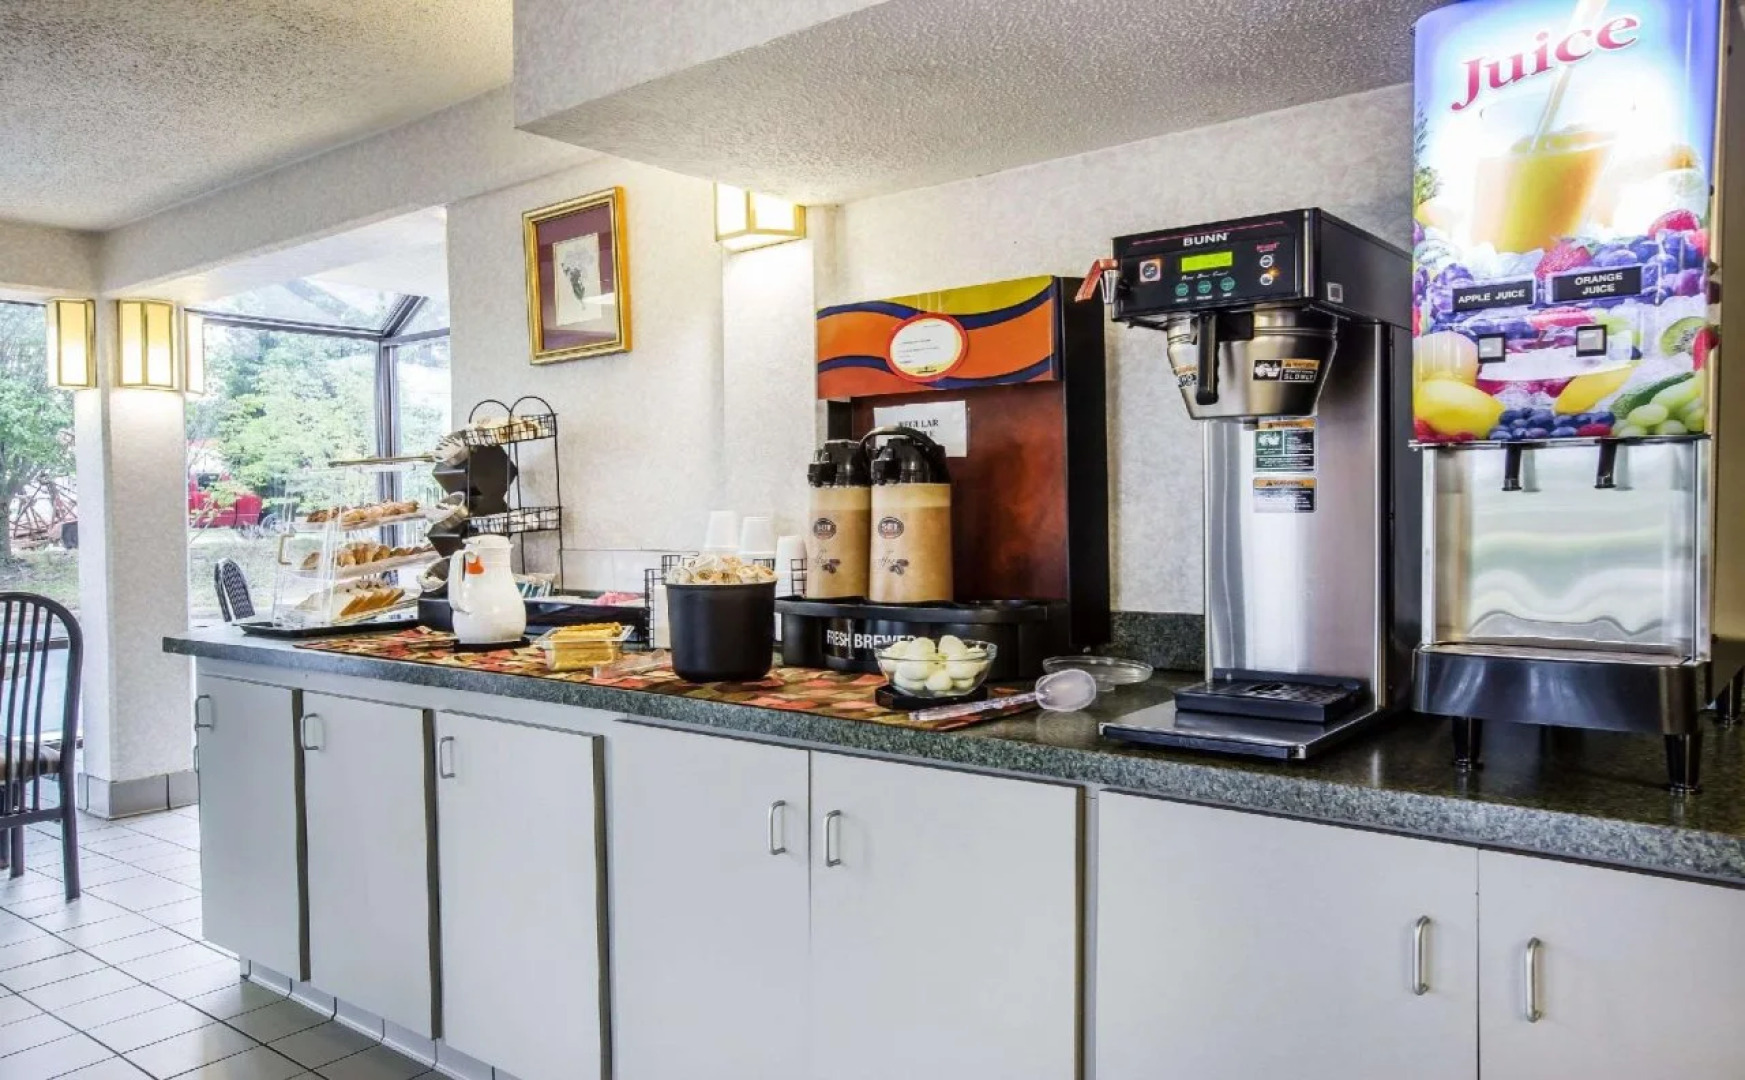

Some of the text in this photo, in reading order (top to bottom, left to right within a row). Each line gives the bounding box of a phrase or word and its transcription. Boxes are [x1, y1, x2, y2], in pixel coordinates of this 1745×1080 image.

[1451, 17, 1638, 111] Juice
[1183, 233, 1228, 246] BUNN
[1574, 272, 1623, 286] ORANGE
[1458, 289, 1525, 304] APPLE JUICE
[1582, 284, 1615, 295] JUICE
[827, 630, 851, 647] FRESH
